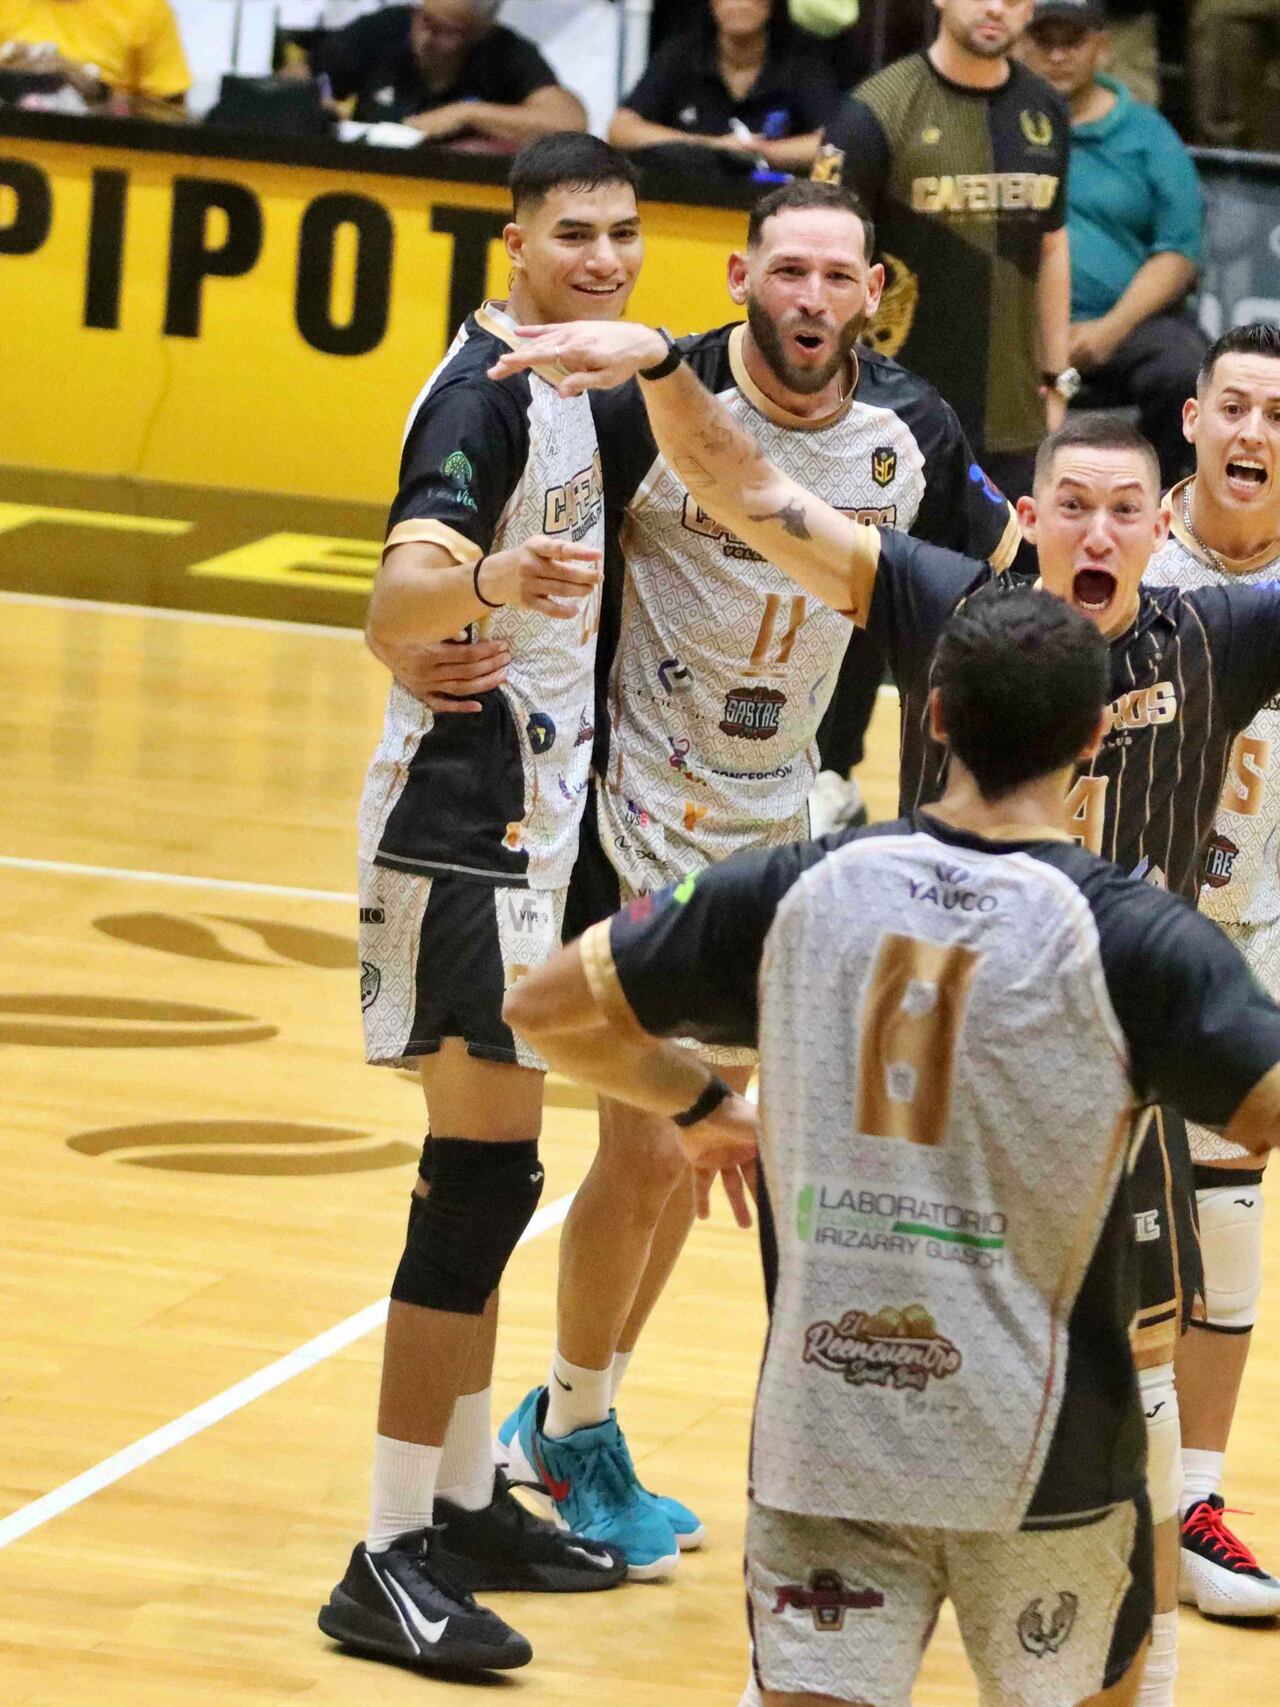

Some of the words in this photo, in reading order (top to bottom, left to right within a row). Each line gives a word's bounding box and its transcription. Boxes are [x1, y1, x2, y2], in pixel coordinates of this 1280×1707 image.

[908, 878, 998, 912] YAUCO
[819, 1186, 1007, 1234] LABORATORIO
[815, 1226, 920, 1255] IRIZARRY
